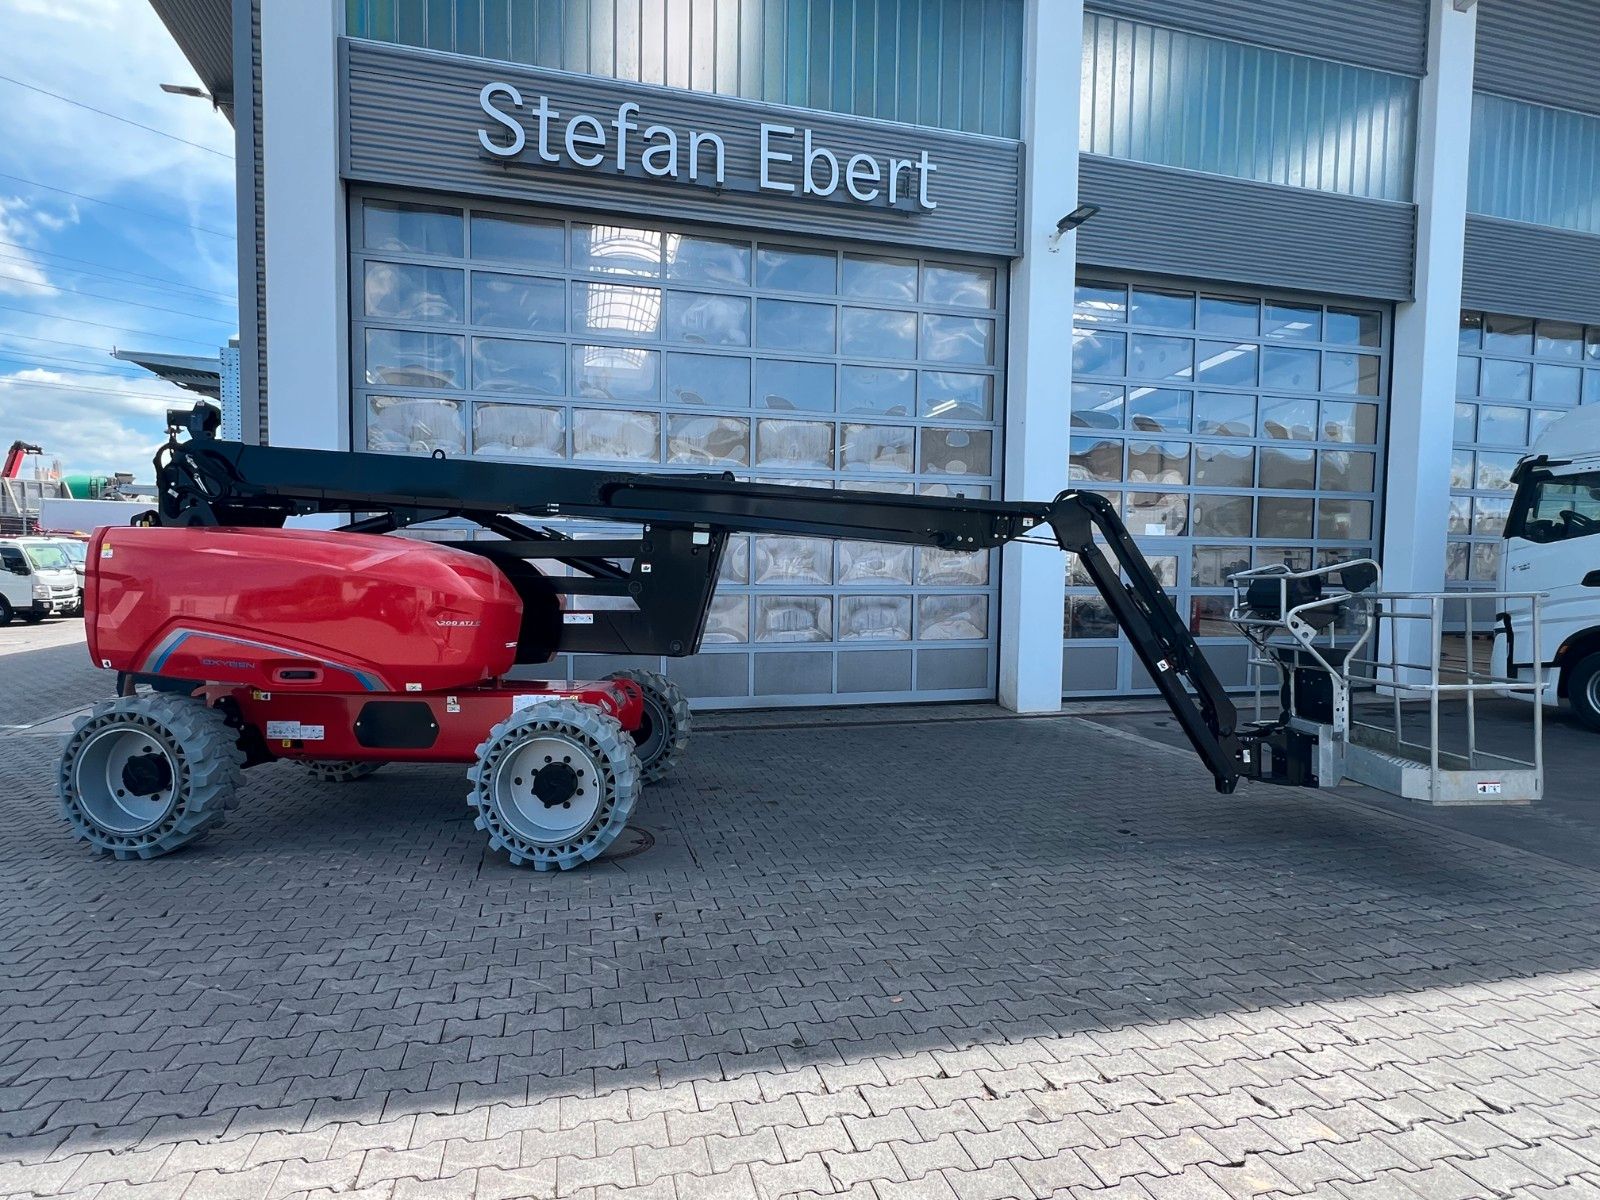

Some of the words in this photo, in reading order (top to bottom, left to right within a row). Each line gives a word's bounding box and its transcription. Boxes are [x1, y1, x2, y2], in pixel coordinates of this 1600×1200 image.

[478, 82, 725, 185] Stefan
[760, 123, 938, 211] Ebert
[202, 659, 255, 669] OXYGEN
